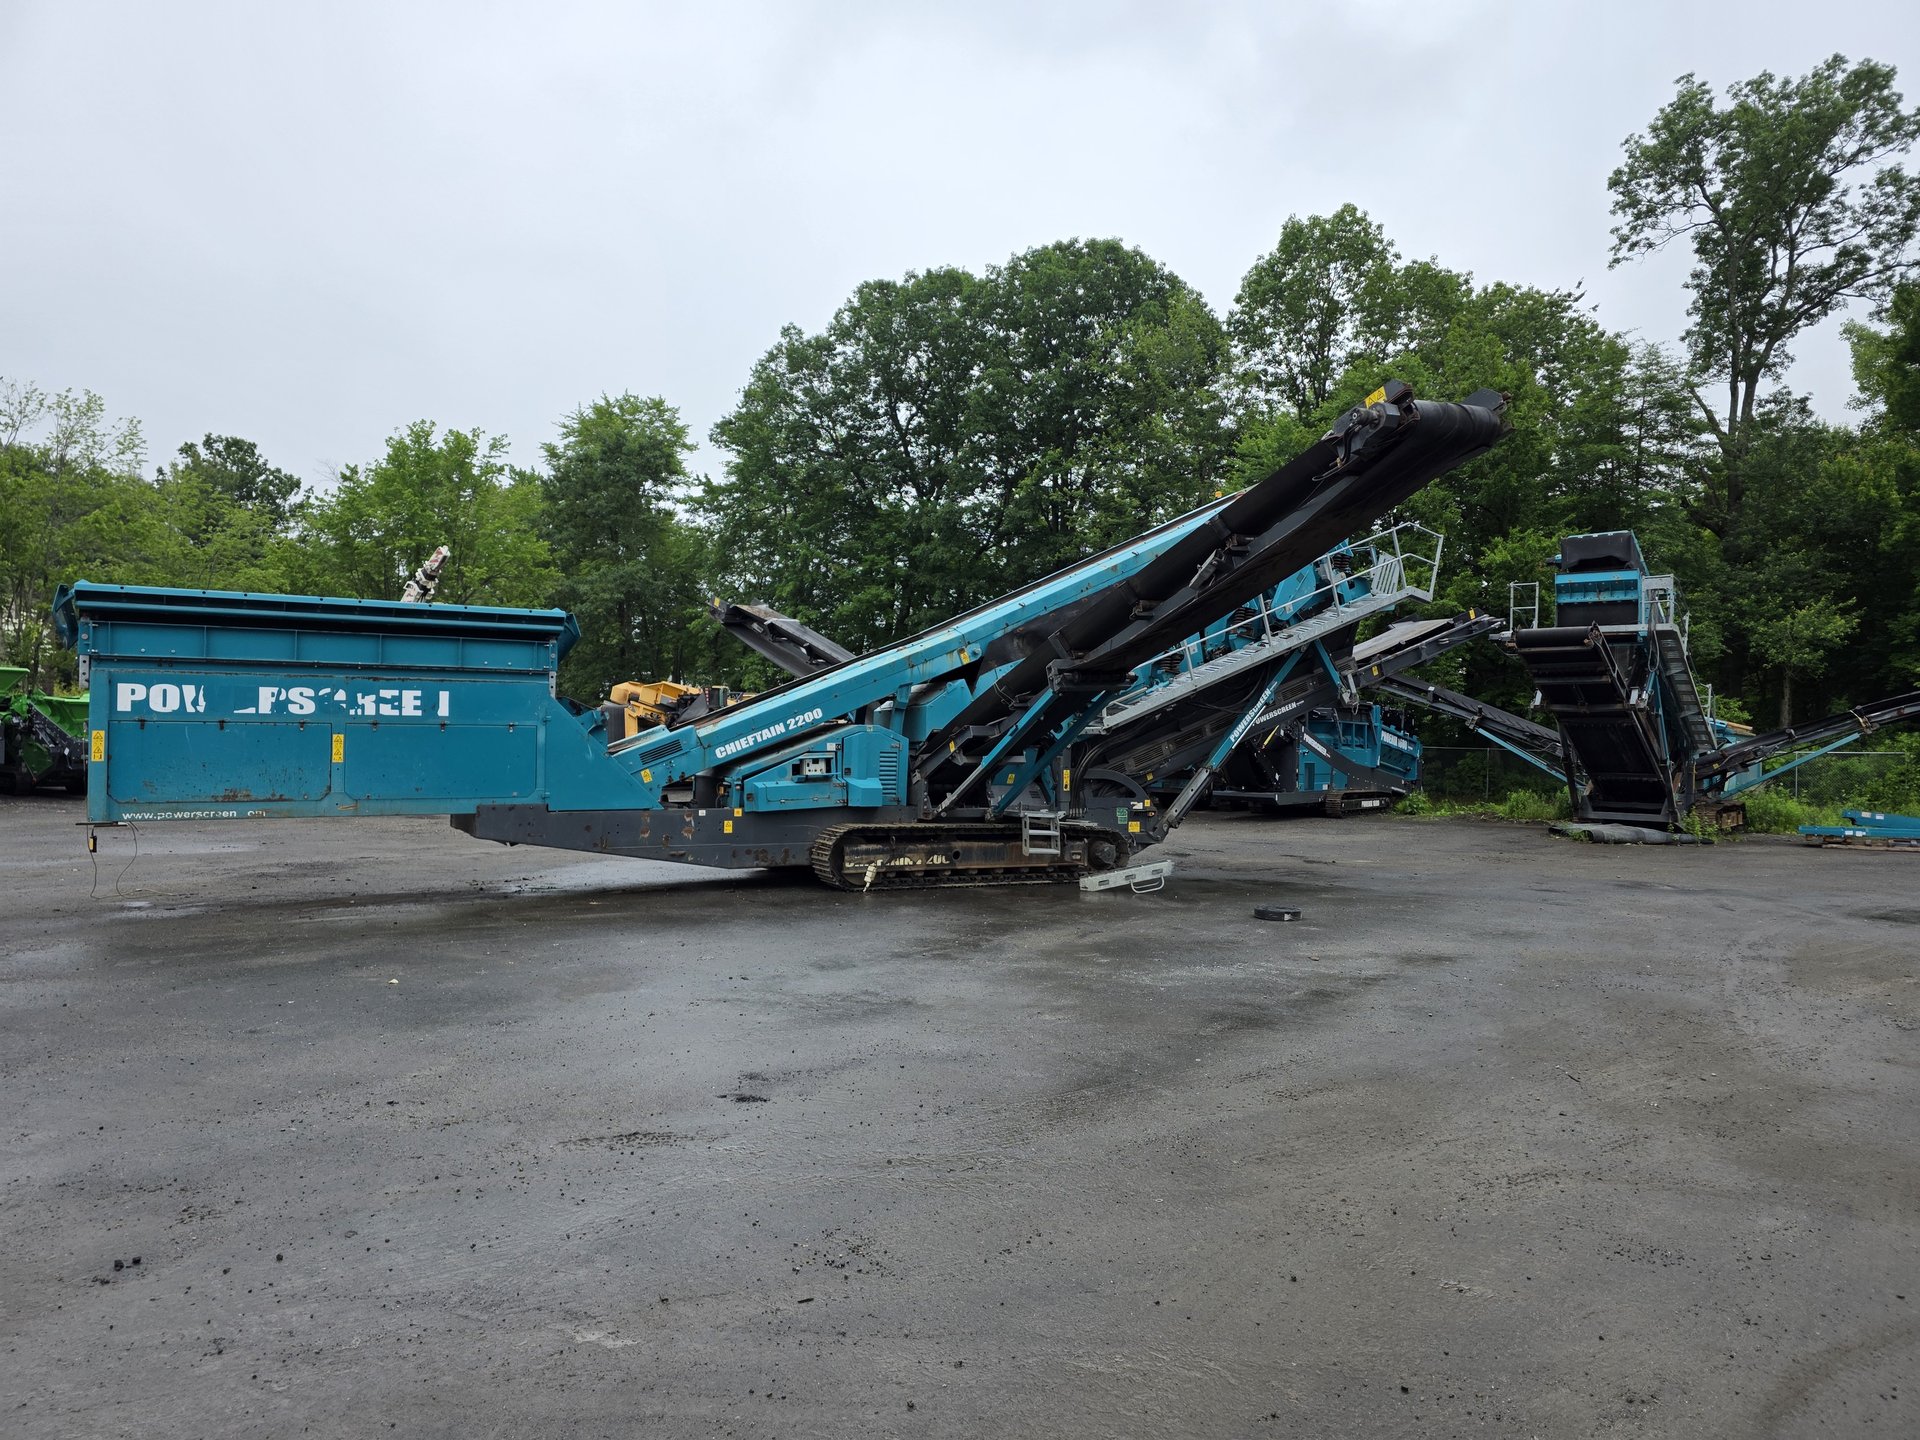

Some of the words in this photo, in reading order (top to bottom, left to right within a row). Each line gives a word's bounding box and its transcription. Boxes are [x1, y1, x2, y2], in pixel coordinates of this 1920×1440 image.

[116, 683, 450, 717] PORSREE
[1229, 688, 1272, 743] POWERSCREEN
[1252, 701, 1297, 726] OWERSCREEN
[714, 722, 786, 759] CHIEFTAIN
[786, 707, 823, 730] 2200
[121, 809, 267, 820] www.powerscrenom
